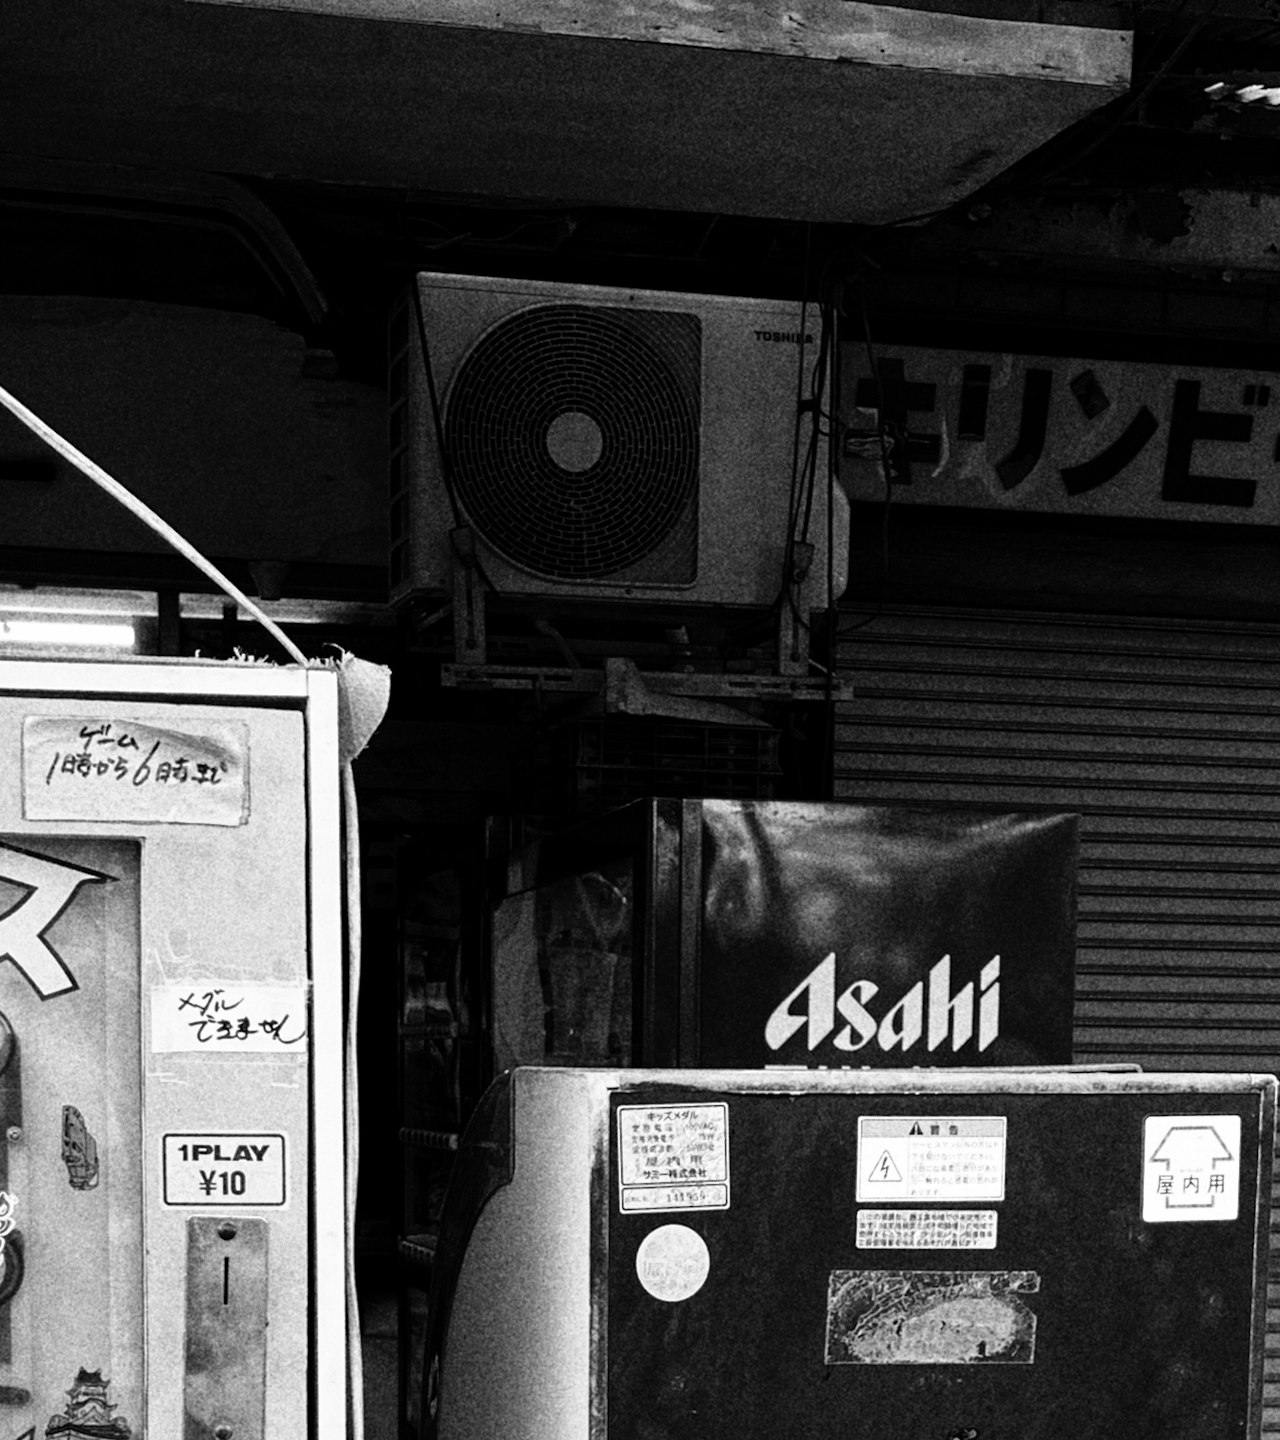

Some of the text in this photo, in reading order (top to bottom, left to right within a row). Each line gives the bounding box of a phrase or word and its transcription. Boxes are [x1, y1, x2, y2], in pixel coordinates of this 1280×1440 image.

[79, 724, 139, 750] ゲーム
[764, 951, 1002, 1053] Asahi
[189, 1014, 306, 1044] できません
[177, 1143, 271, 1162] 1PLAY
[198, 1170, 247, 1197] ¥10
[1156, 1174, 1225, 1195] 屋内用
